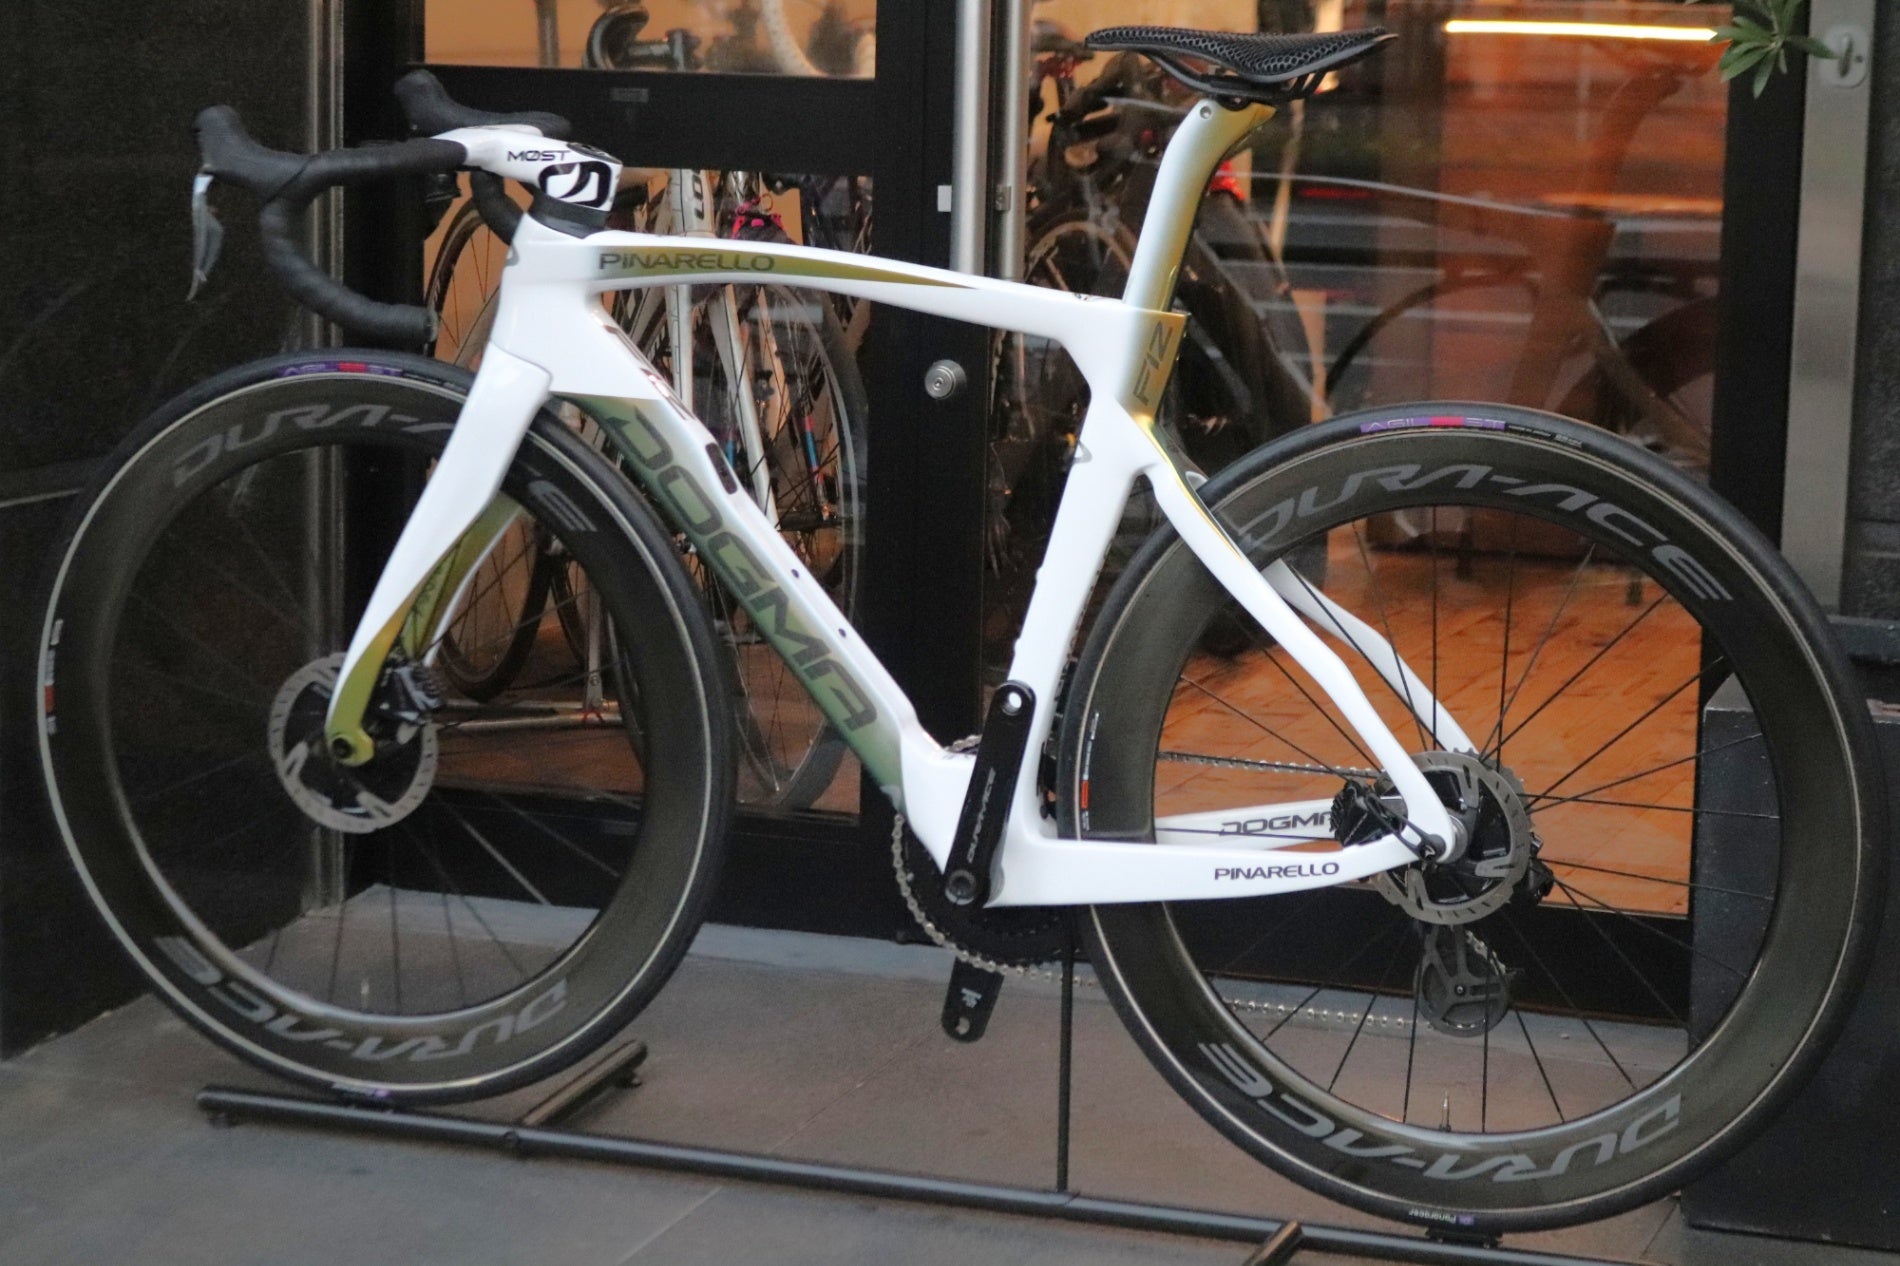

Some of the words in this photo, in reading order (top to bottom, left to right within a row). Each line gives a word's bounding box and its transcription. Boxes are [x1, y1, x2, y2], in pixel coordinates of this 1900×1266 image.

[599, 253, 774, 272] PINARELLO
[606, 405, 877, 732] DOGMA
[1238, 464, 1733, 601] DURA-ACE
[1215, 862, 1340, 880] PINARELLO
[1199, 1043, 1681, 1182] DURA-ACE
